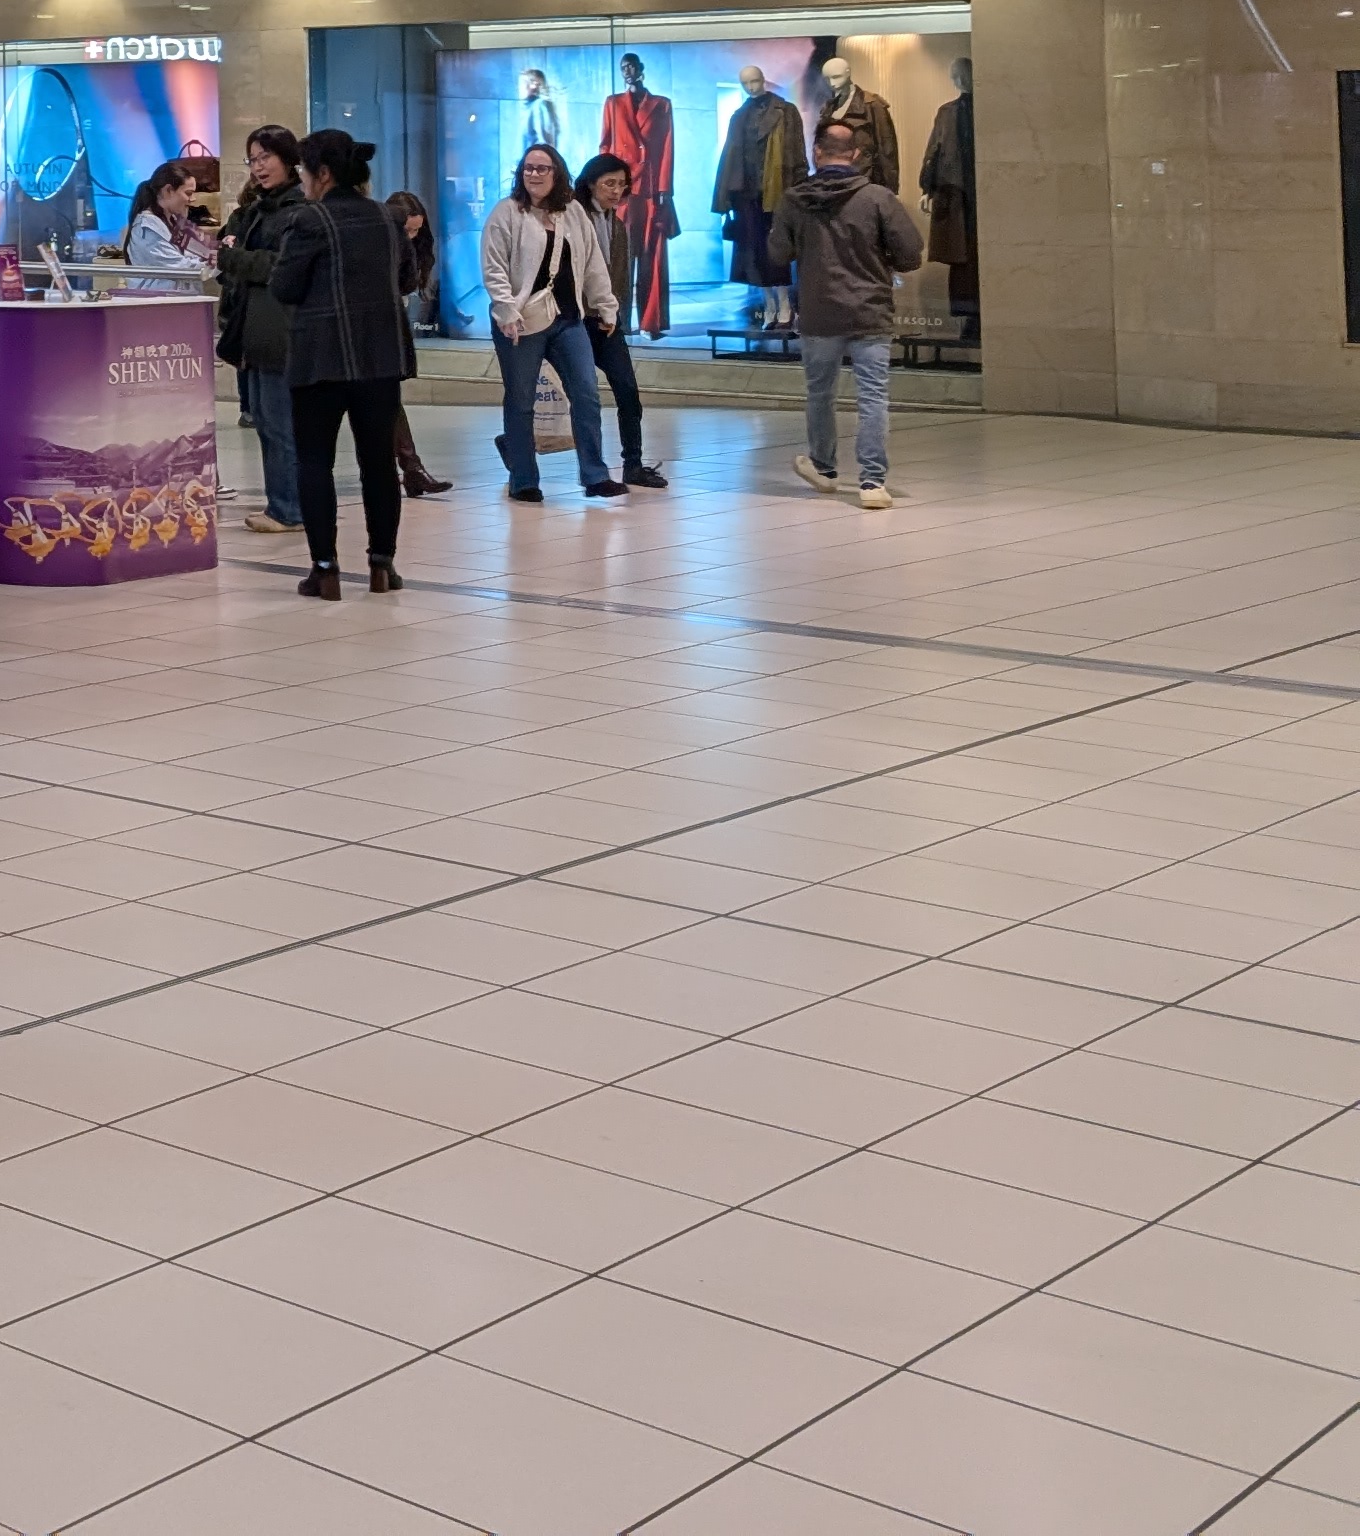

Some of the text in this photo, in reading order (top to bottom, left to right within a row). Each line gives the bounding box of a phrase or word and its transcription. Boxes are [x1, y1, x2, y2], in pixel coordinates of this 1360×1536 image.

[413, 321, 434, 331] Floor
[170, 342, 193, 357] 2026
[108, 356, 204, 385] SHEN YUN
